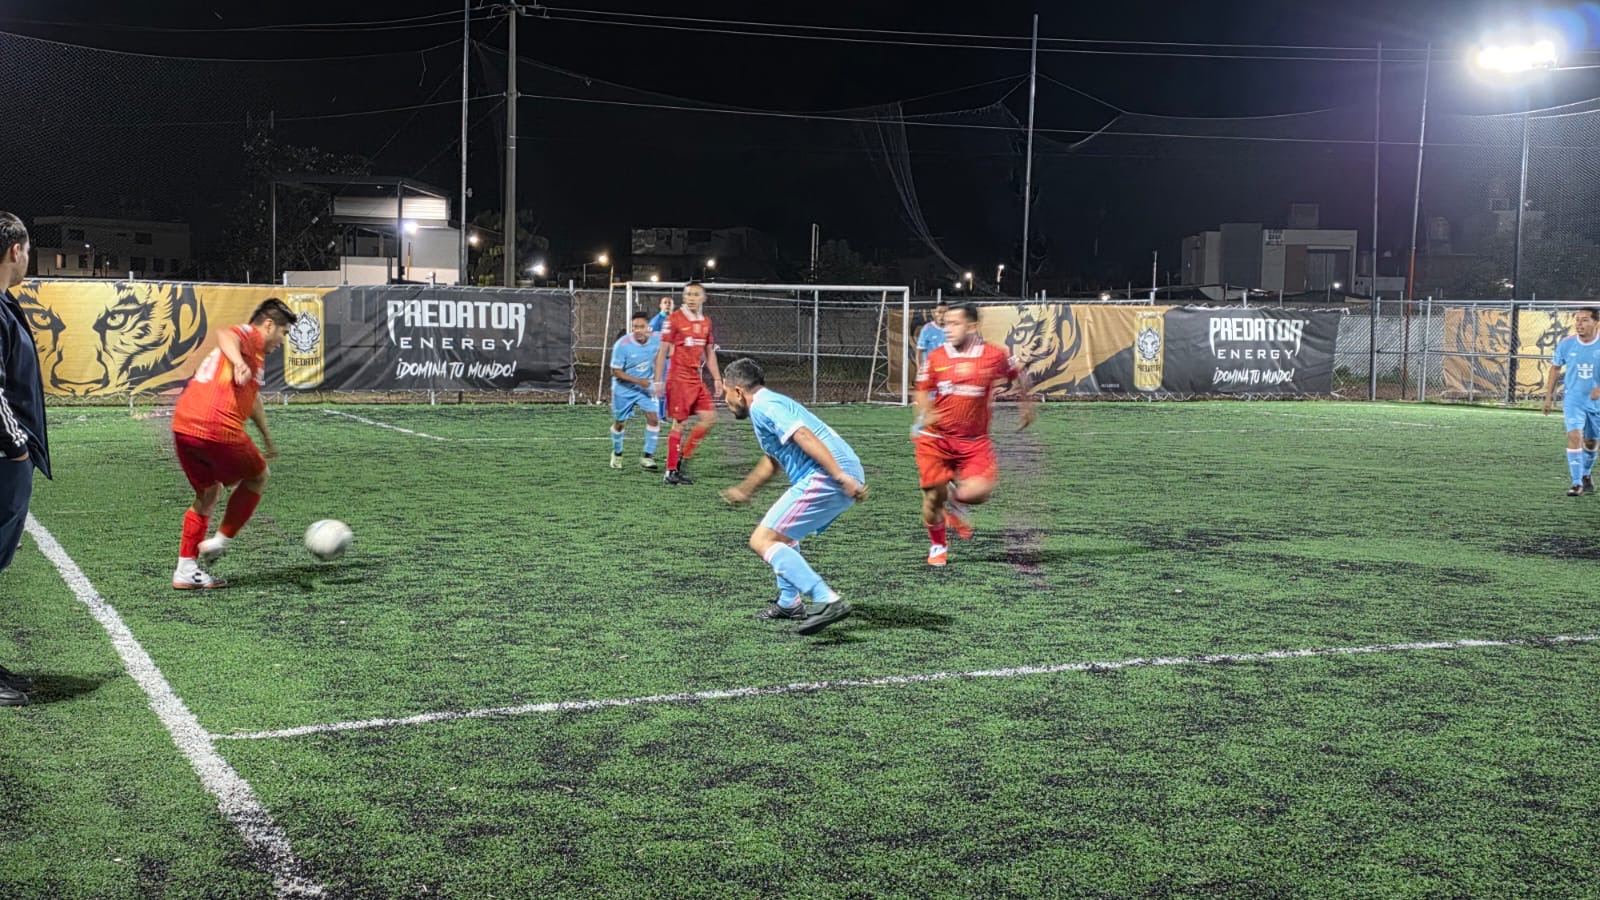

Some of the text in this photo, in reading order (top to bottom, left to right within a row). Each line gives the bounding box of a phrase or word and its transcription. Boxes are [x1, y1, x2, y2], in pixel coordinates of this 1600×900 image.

[387, 299, 526, 347] PREDATOR
[400, 337, 514, 351] ENERGY
[1209, 317, 1304, 357] PREDATOR
[1218, 348, 1294, 360] ENERGY
[448, 361, 465, 380] TU
[467, 360, 517, 380] MUNDO!
[1250, 368, 1262, 385] TU
[1262, 367, 1295, 385] MUNDO!
